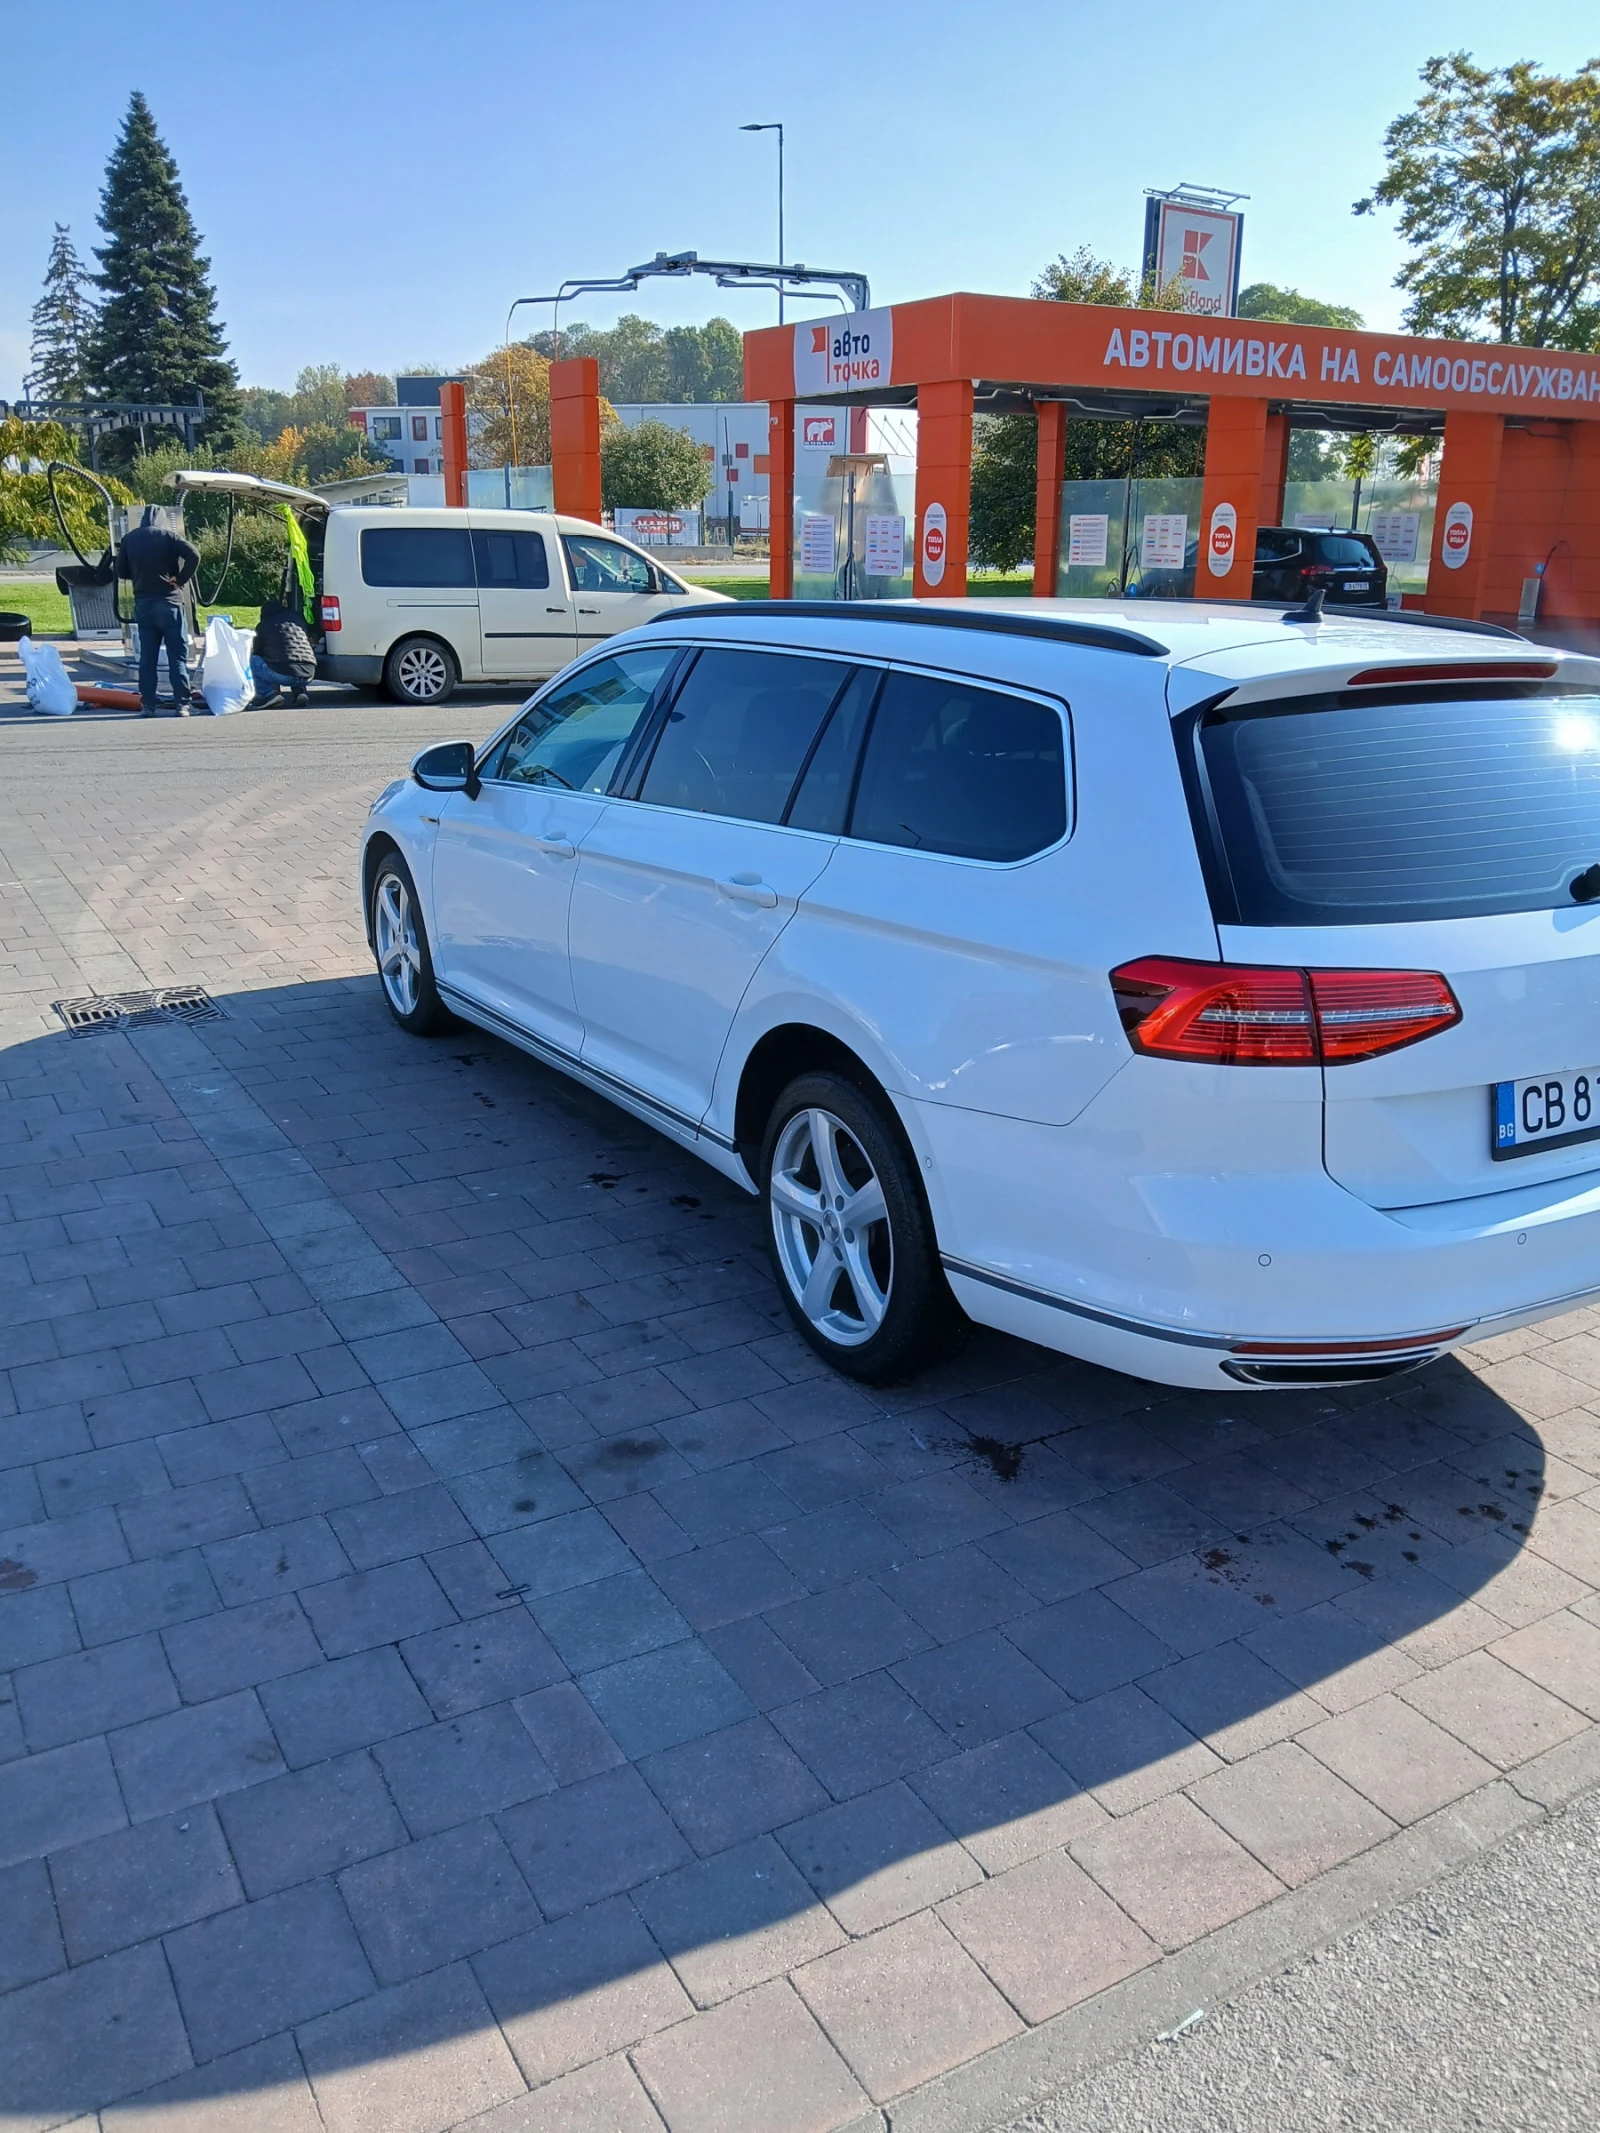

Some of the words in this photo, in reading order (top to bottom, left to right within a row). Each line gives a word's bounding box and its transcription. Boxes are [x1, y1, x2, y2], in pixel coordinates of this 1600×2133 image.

[833, 359, 880, 383] точка
[1103, 328, 1307, 380] АВТОМИВКА
[1320, 346, 1360, 384] НА
[1522, 1081, 1565, 1134] CB
[1574, 1075, 1600, 1122] 8
[1499, 1123, 1514, 1139] BG
